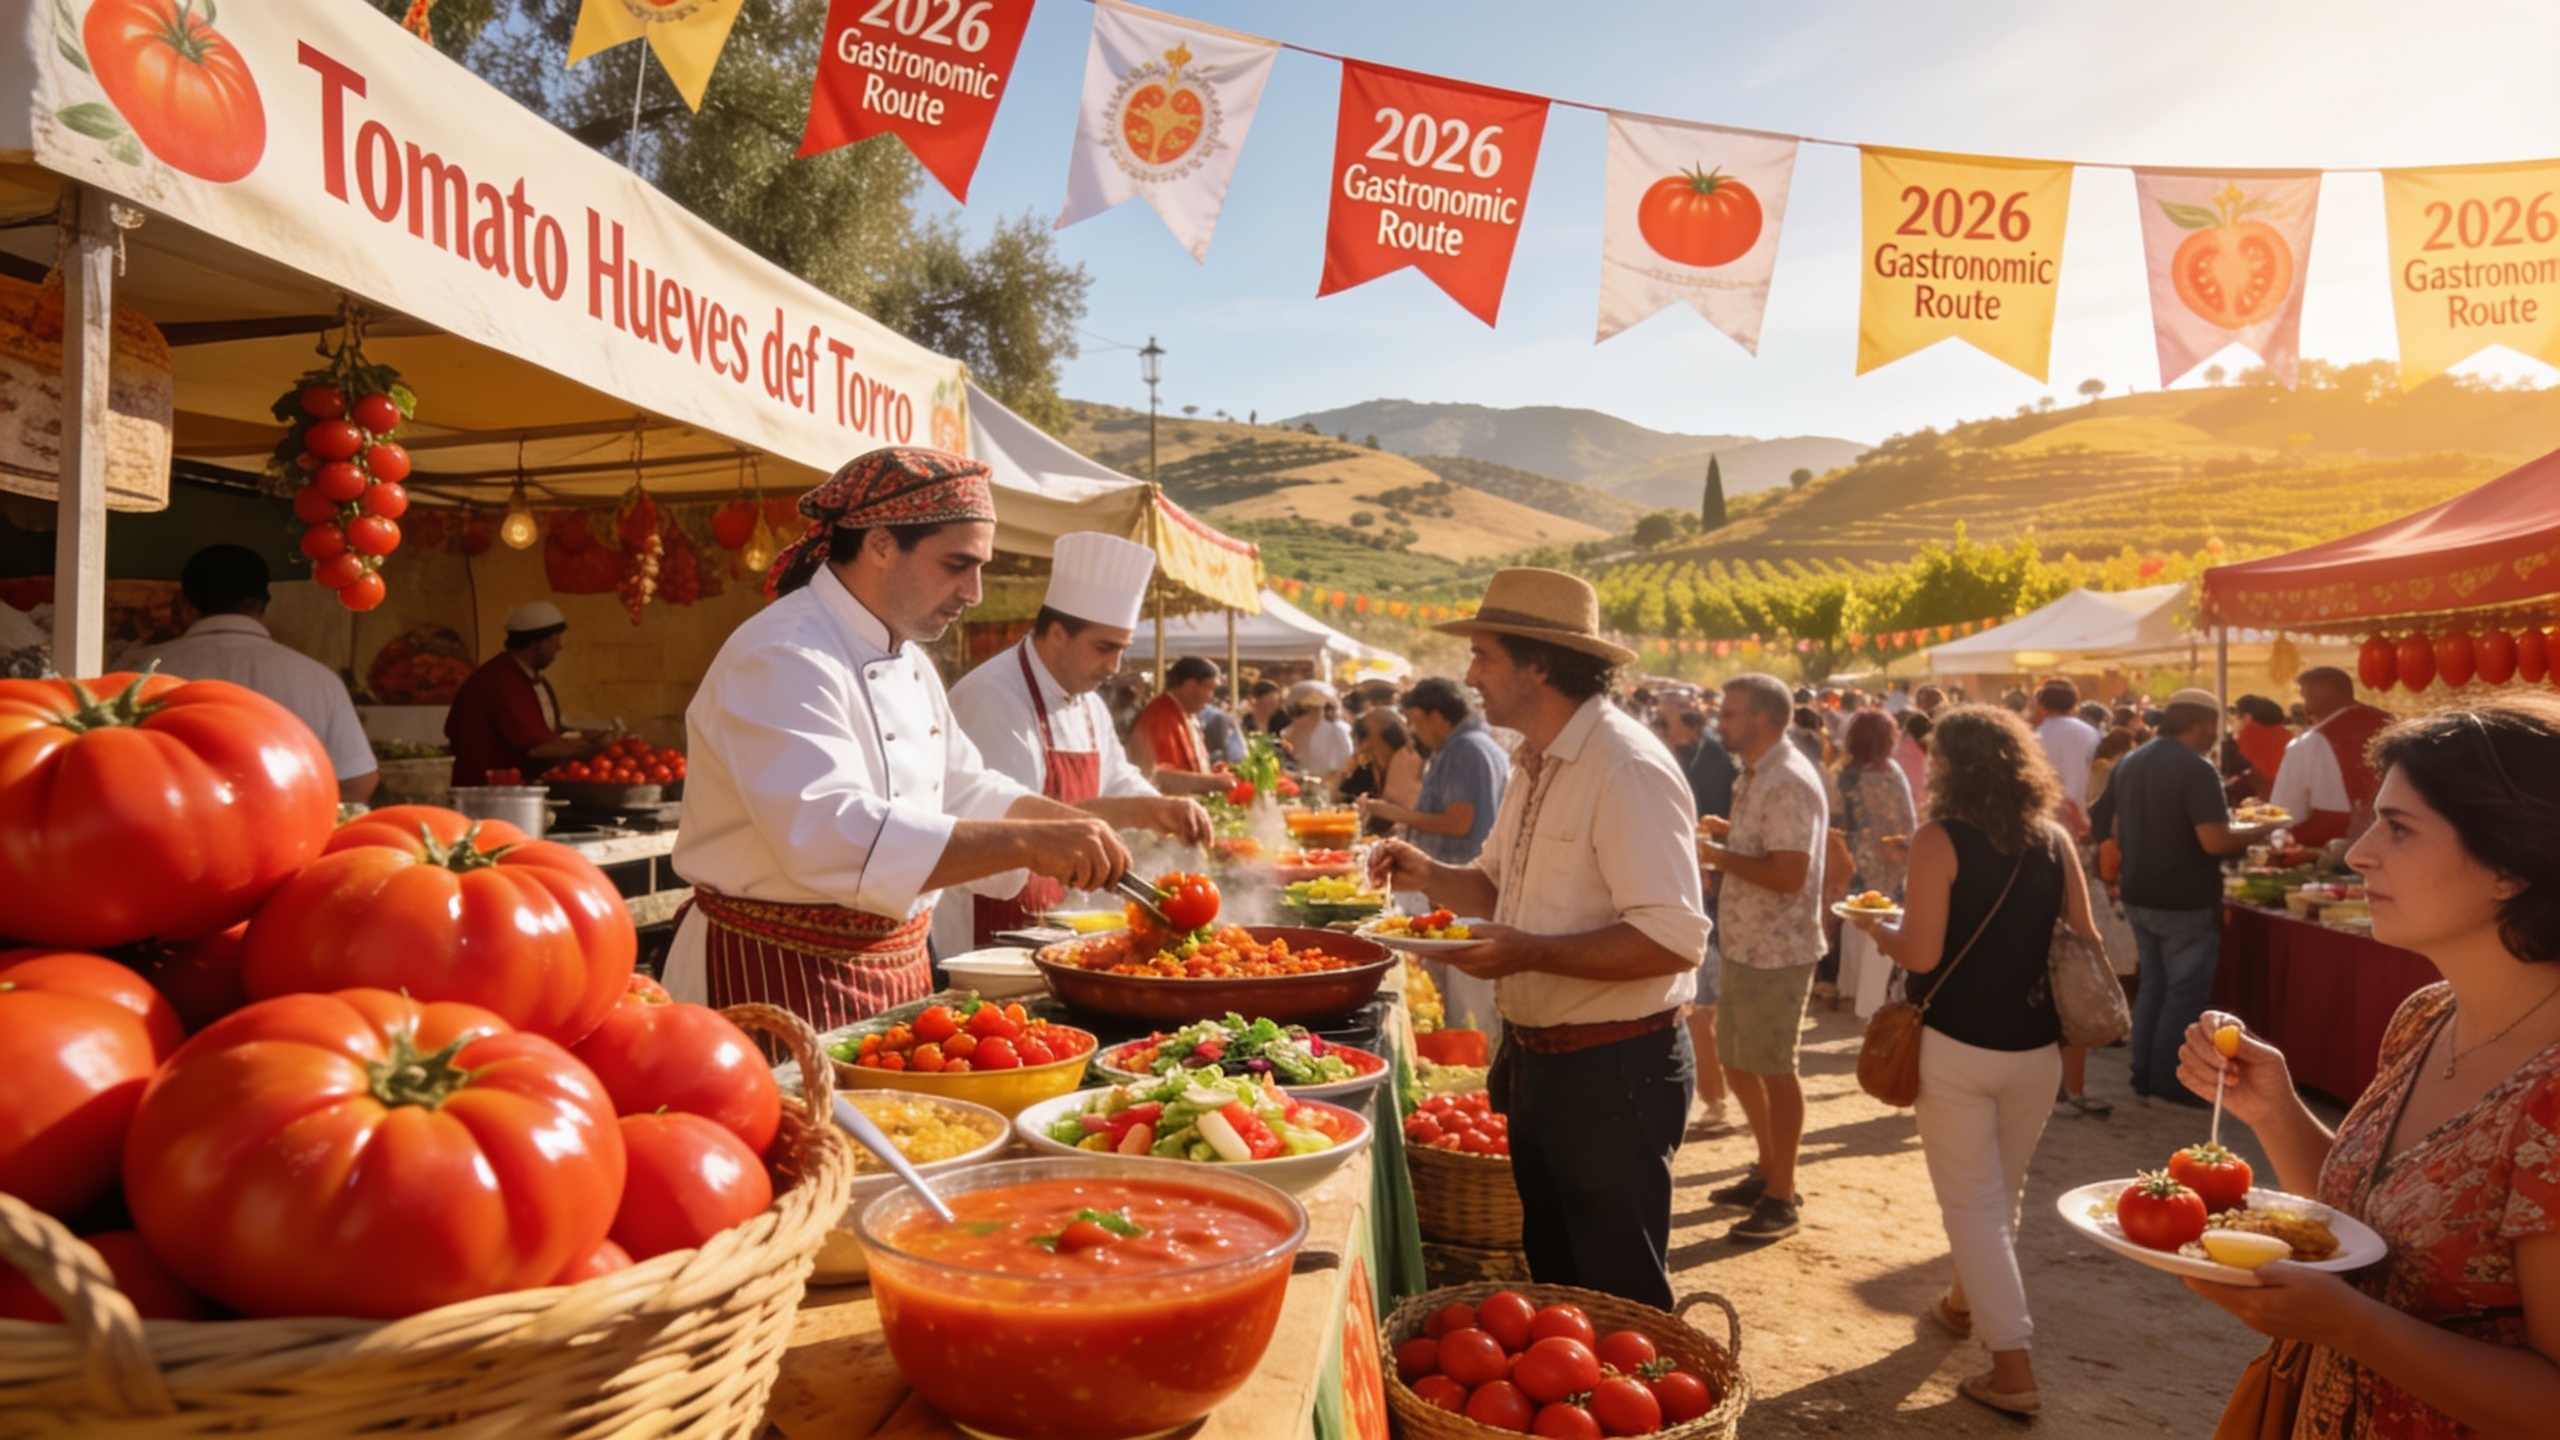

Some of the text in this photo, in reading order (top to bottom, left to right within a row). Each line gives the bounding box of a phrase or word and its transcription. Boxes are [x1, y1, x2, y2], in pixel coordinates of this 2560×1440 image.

[857, 0, 994, 53] 2026
[837, 27, 999, 99] Gastronomic
[861, 73, 945, 126] Route
[1365, 107, 1504, 178] 2026
[1343, 163, 1518, 226] Gastronomic
[1895, 185, 2031, 242] 2026
[2422, 191, 2560, 251] 2026
[297, 38, 569, 302] Tomato
[586, 206, 749, 384] Hueves
[827, 336, 913, 444] Torro
[1376, 209, 1464, 256] Route
[1873, 243, 2055, 286] Gastronomic
[2403, 257, 2560, 292] Gastronom
[1913, 285, 2002, 321] Route
[2447, 294, 2539, 329] Route
